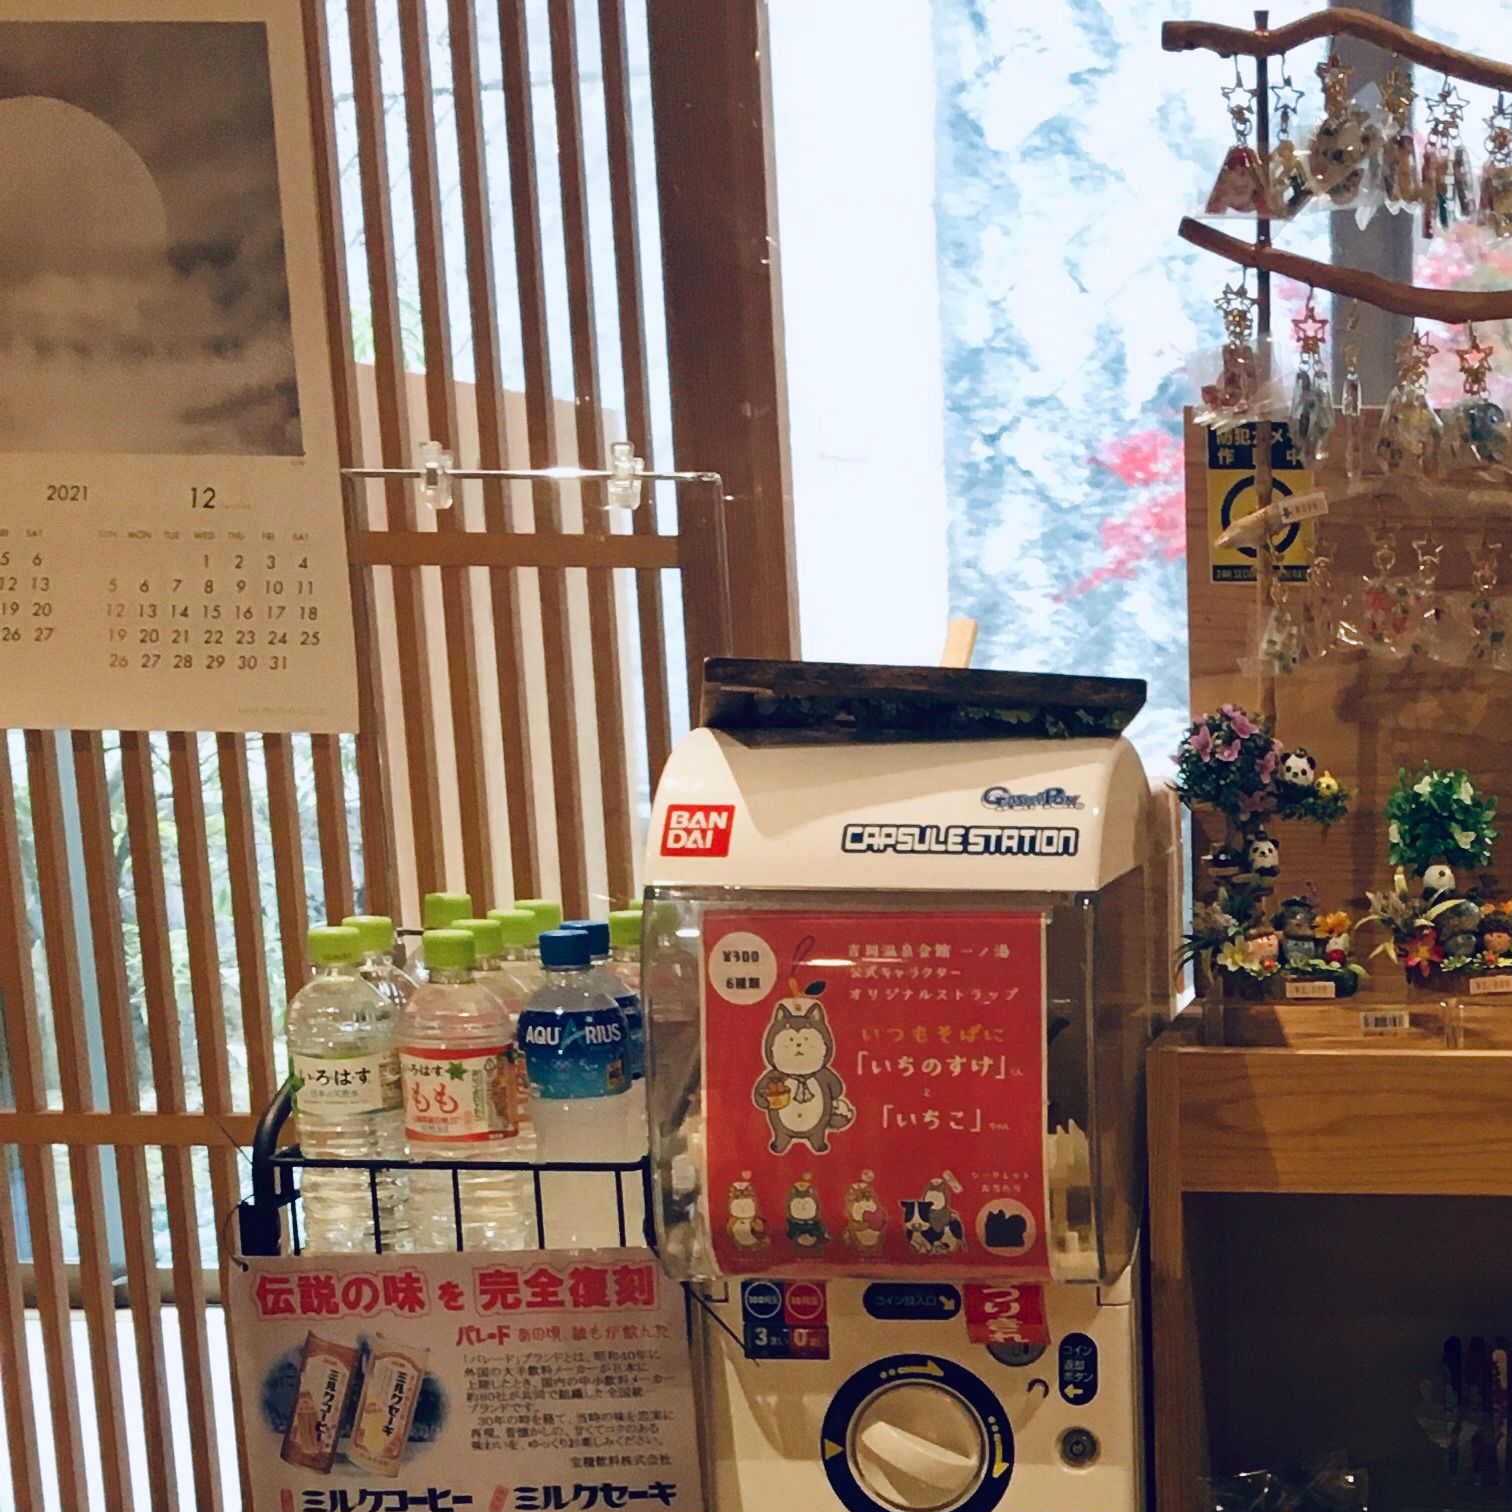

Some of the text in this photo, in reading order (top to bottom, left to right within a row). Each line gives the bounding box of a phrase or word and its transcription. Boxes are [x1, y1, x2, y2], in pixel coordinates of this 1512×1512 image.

[46, 485, 89, 501] 2021
[190, 487, 216, 509] 12
[127, 531, 152, 540] MON
[164, 531, 181, 540] TUE
[193, 531, 216, 541] WED
[0, 554, 42, 566] 5 6
[203, 555, 309, 570] 1 2 3 4
[0, 578, 50, 592] 12 13
[107, 580, 314, 595] 5 6 7 8 9 10 11
[1, 603, 52, 617] 19 20
[106, 604, 318, 621] 12 13 14 15 16 17 18
[2, 627, 54, 642] 26 27
[108, 628, 320, 646] 19 20 21 22 23 24 25
[108, 653, 288, 670] 26 27 28 29 30 31
[670, 810, 728, 829] BAN
[666, 831, 713, 849] DAI
[843, 825, 1078, 855] CAPSULE STATION
[722, 951, 760, 963] ¥300
[849, 986, 1019, 1002] オリジナルストラップ
[525, 1022, 622, 1056] AQUARIUS
[861, 1024, 1004, 1044] いつもそばに
[411, 1082, 459, 1113] もも
[514, 1482, 678, 1511] ミルクセーキ
